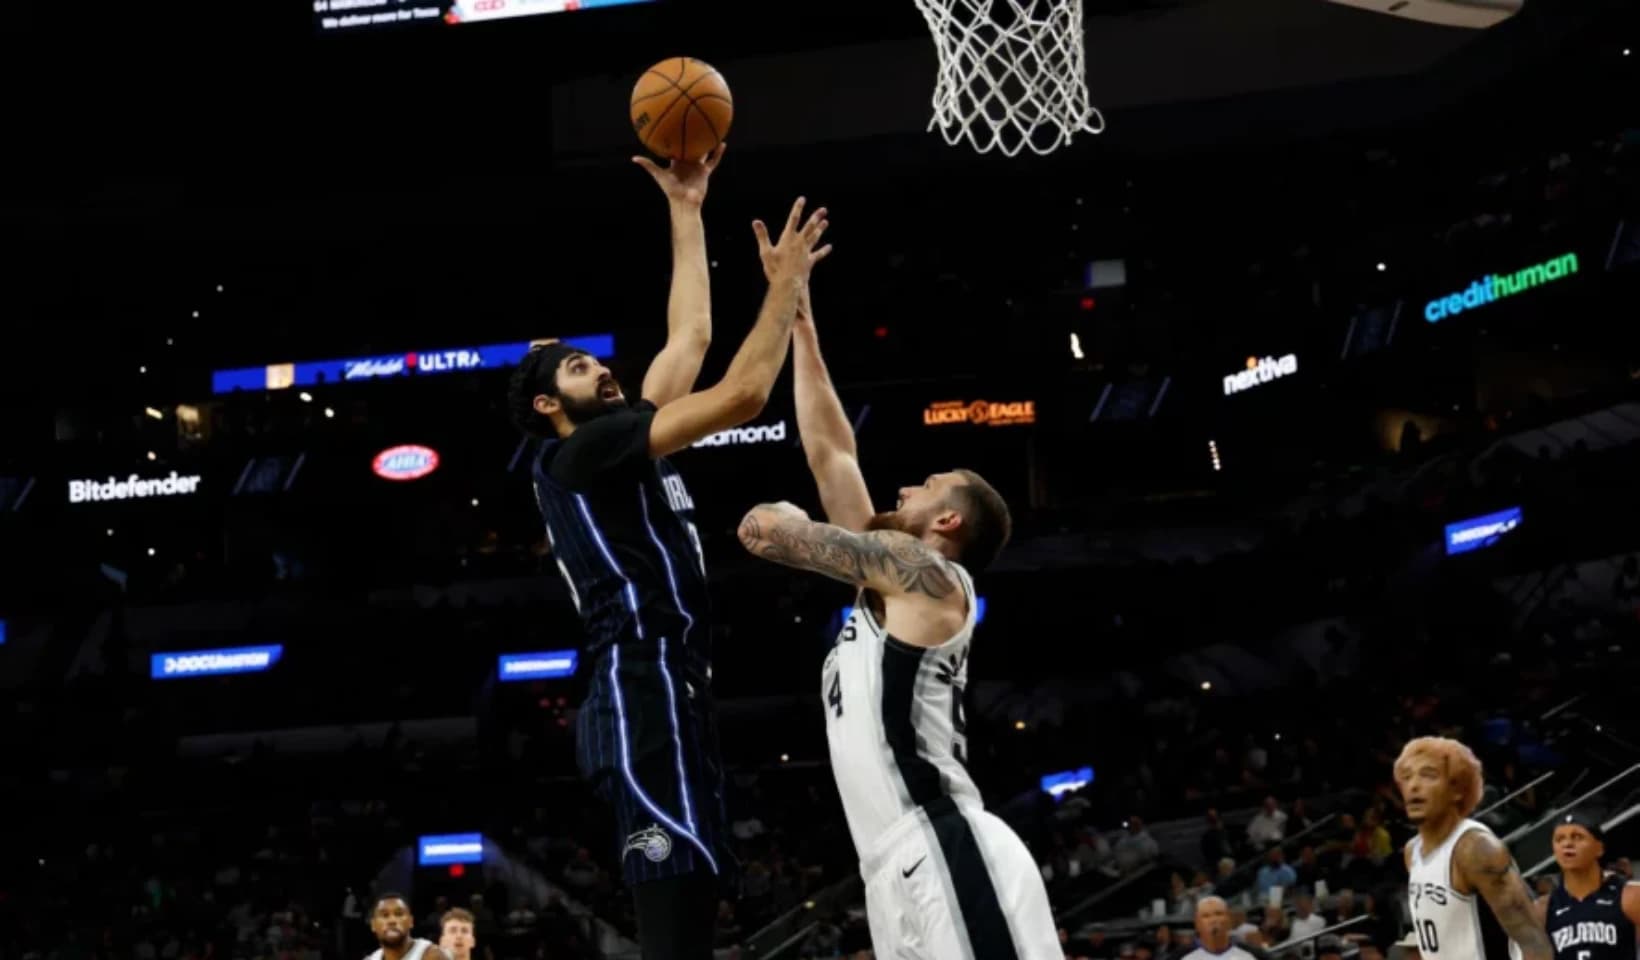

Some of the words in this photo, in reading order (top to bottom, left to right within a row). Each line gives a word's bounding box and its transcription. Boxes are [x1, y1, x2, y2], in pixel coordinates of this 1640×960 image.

[1223, 353, 1298, 396] nextiva
[69, 470, 201, 503] Bitdefender
[1415, 918, 1439, 954] 10
